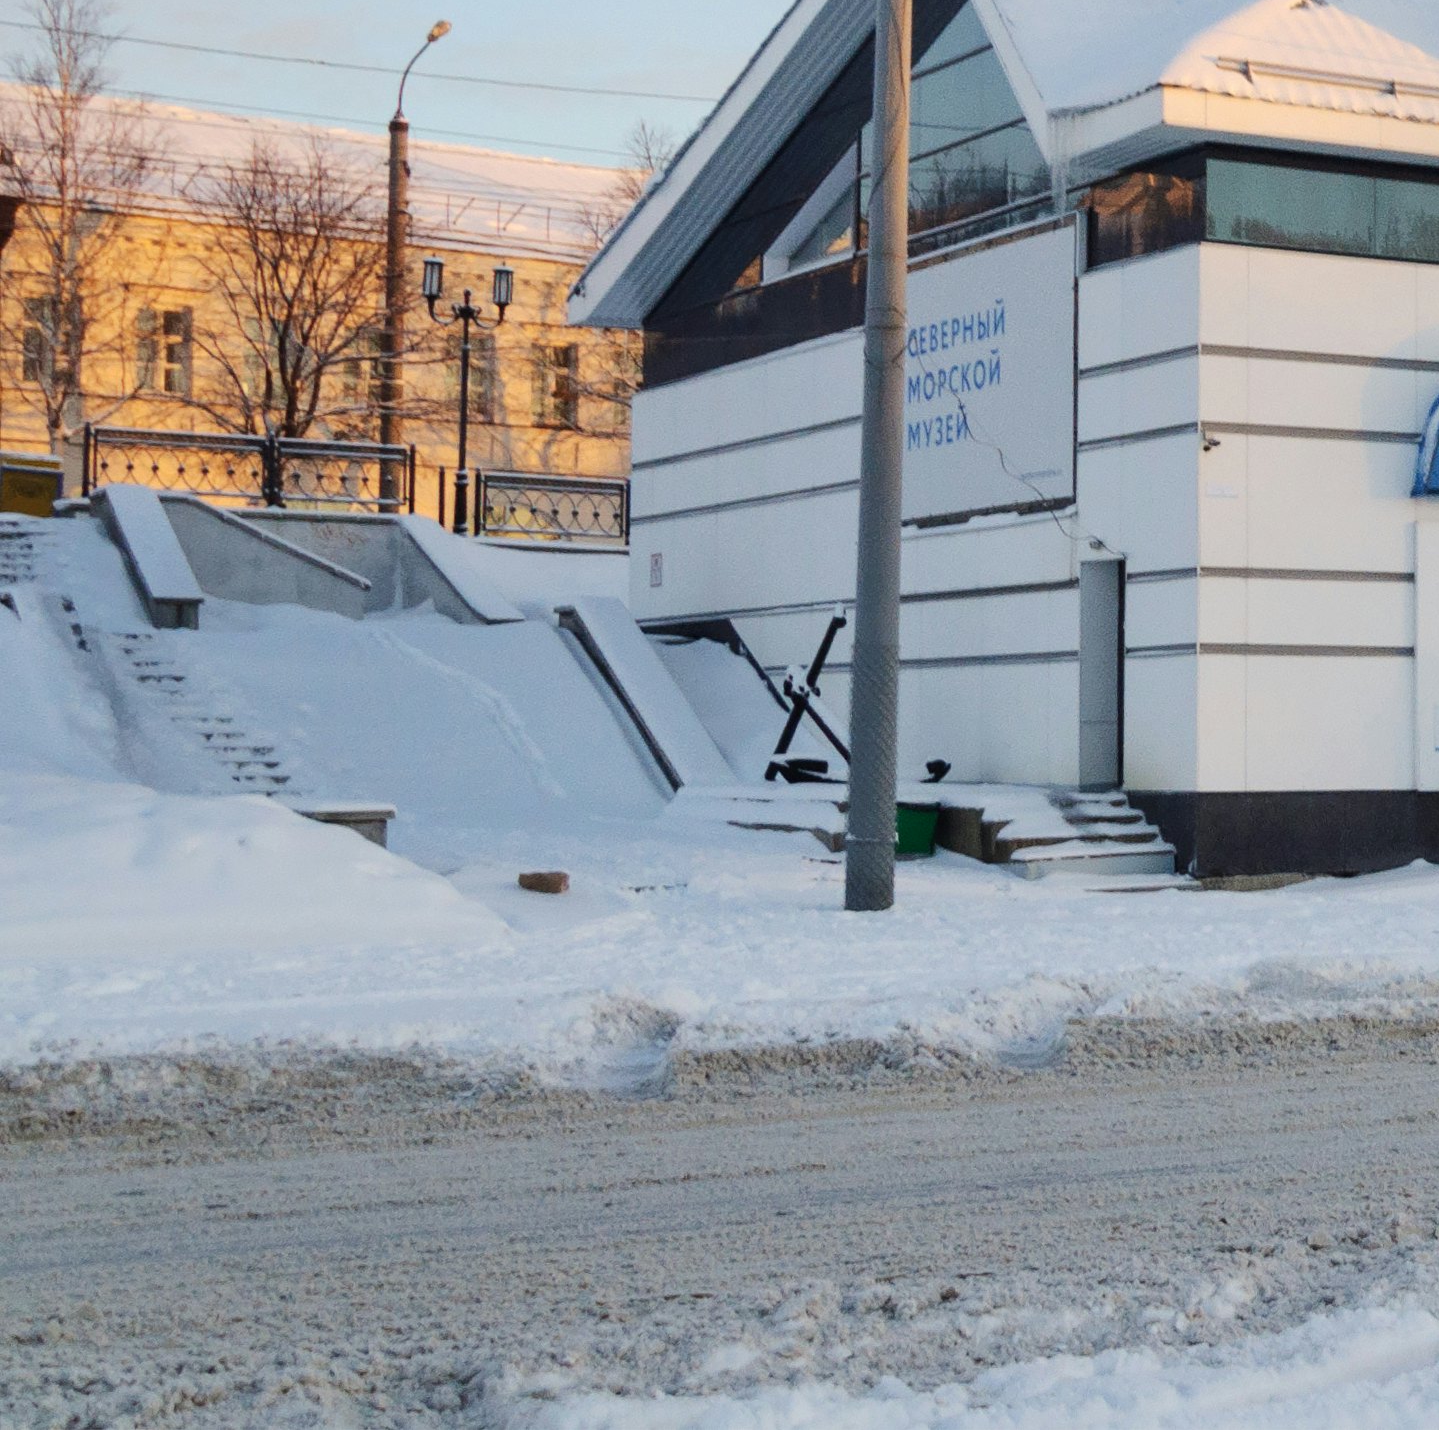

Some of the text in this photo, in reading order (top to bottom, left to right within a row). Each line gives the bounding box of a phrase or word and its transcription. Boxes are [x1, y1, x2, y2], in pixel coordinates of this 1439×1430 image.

[907, 298, 1005, 357] СЕВЕРНЫЙ
[908, 348, 1000, 403] МОРСКОЙ
[908, 404, 968, 450] МУЗЕЙ
